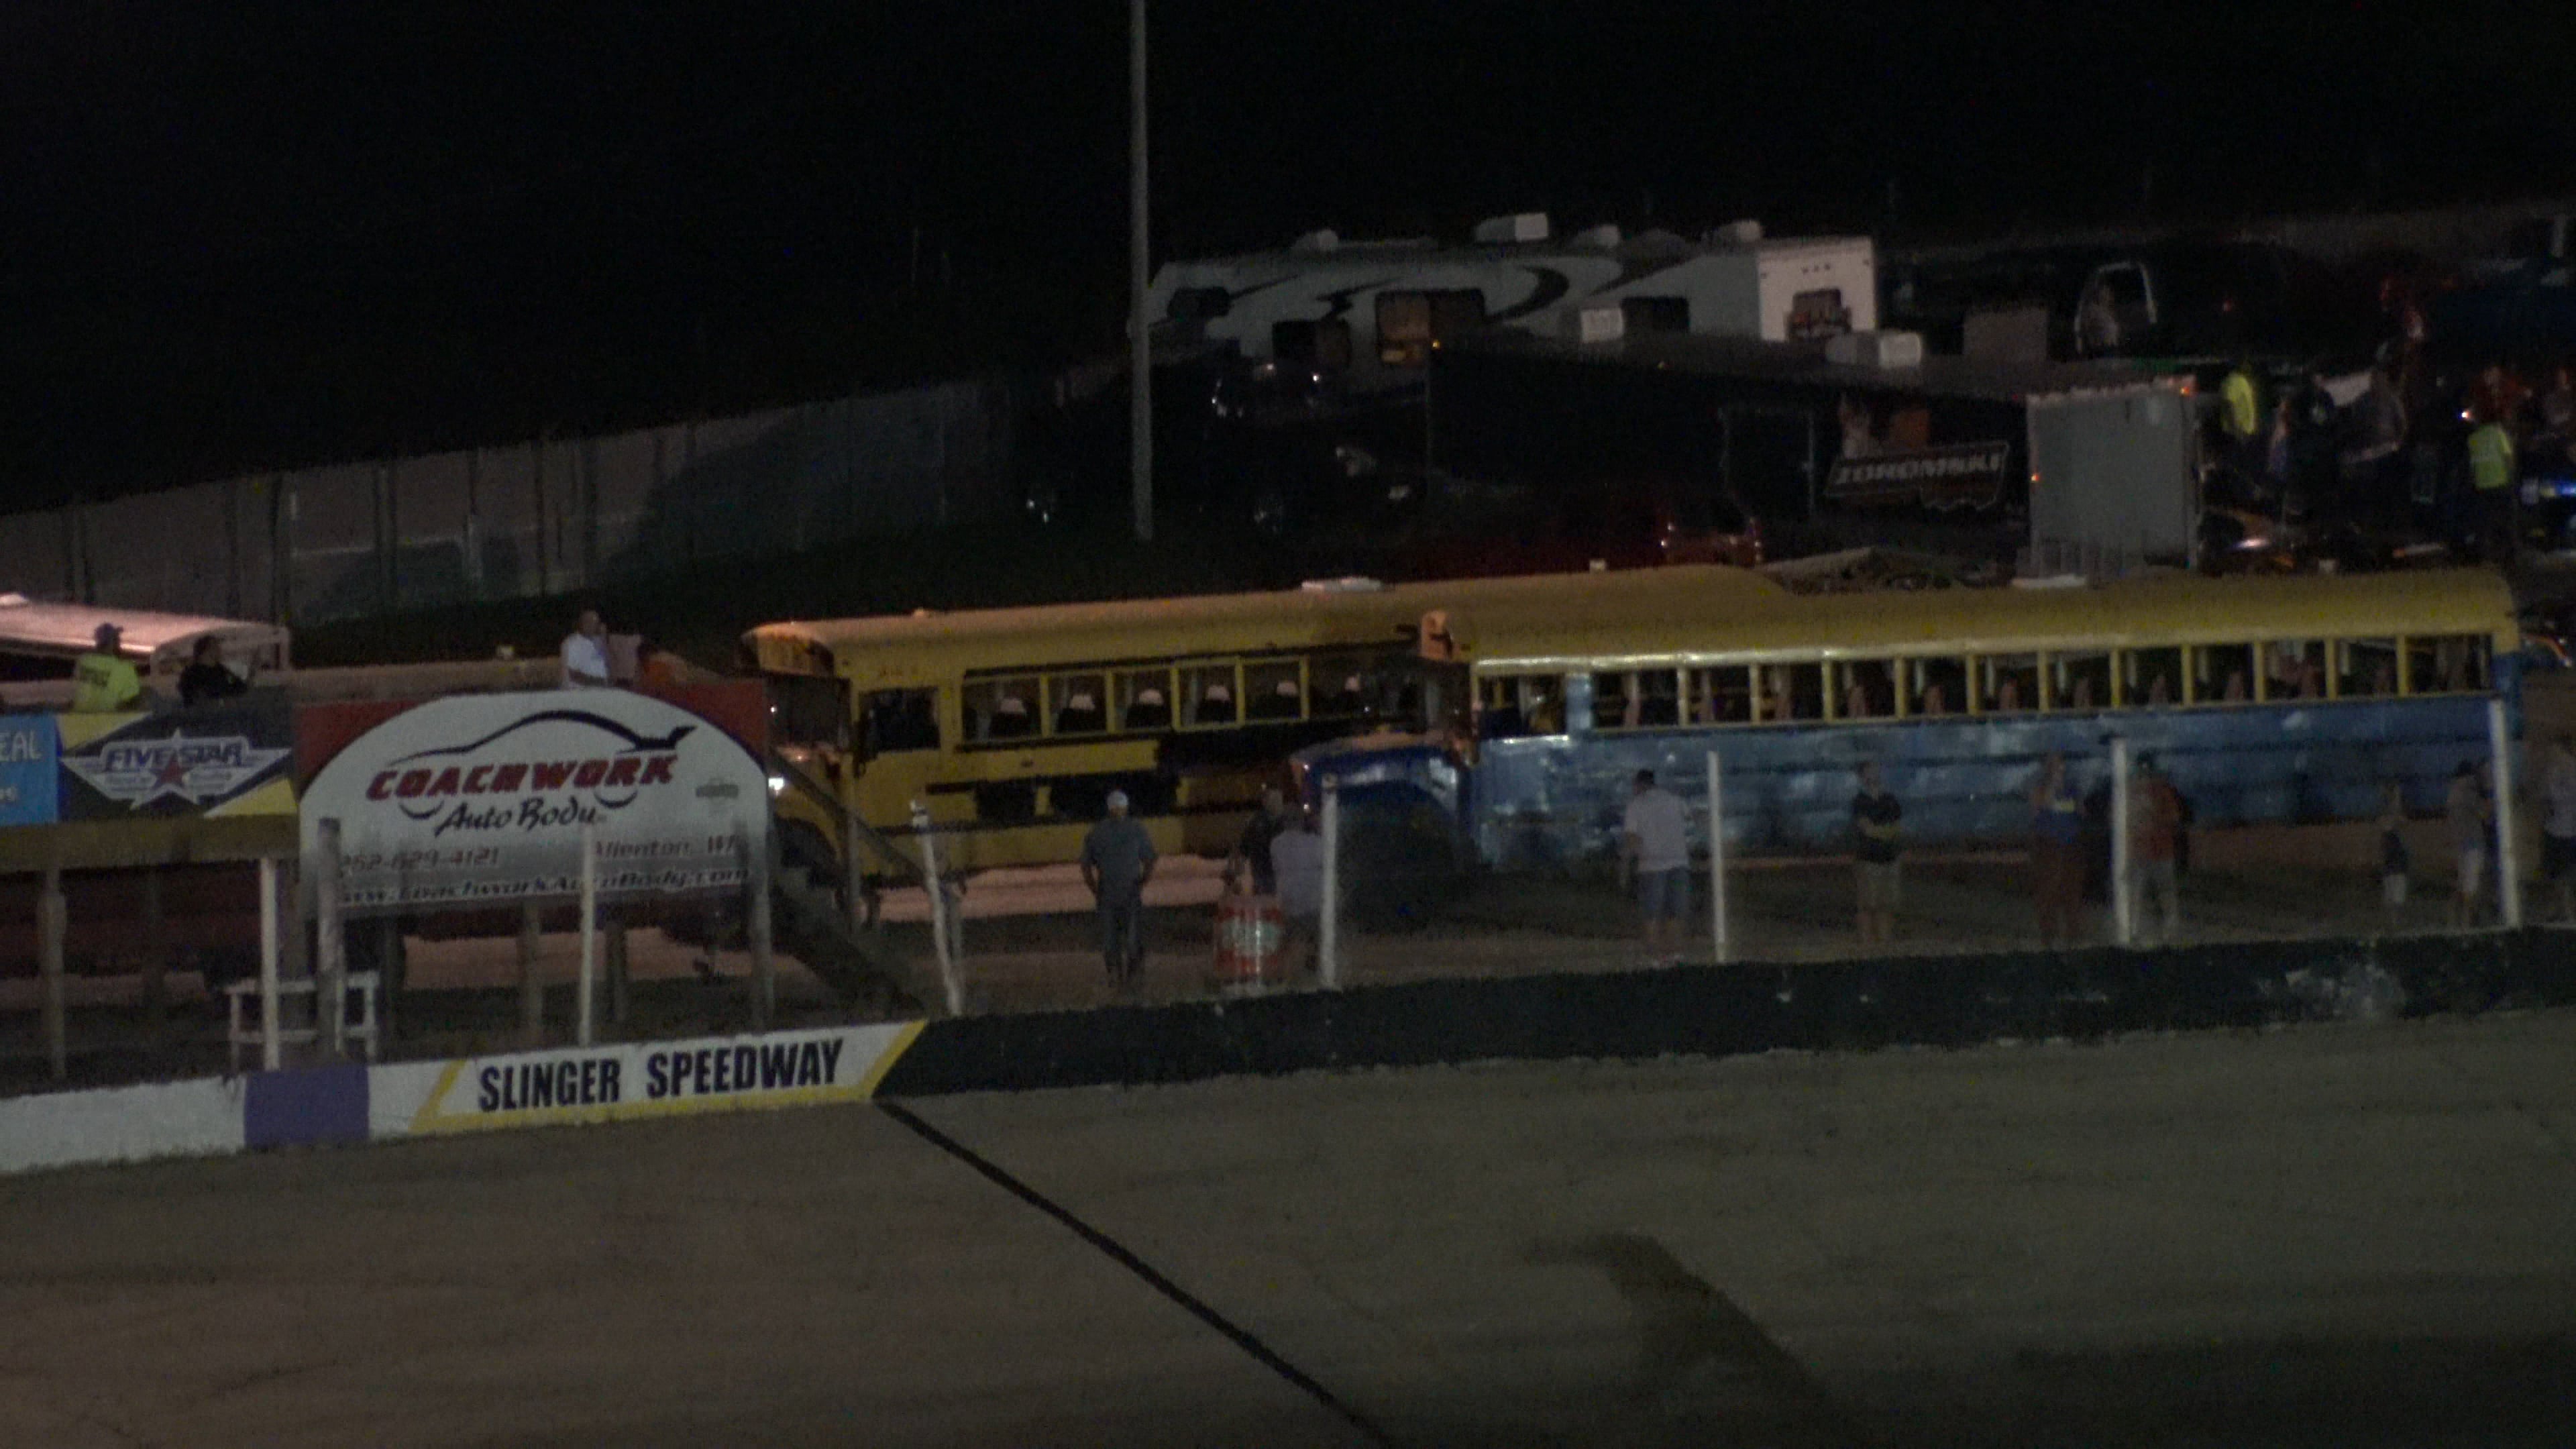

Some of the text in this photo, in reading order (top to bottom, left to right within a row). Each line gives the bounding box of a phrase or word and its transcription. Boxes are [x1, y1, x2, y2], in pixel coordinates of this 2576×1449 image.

[105, 743, 243, 772] FIVE STAR
[366, 755, 678, 800] COACHWORK
[434, 804, 514, 838] Auto
[479, 1038, 843, 1112] SLINGER SPEEDWAY
